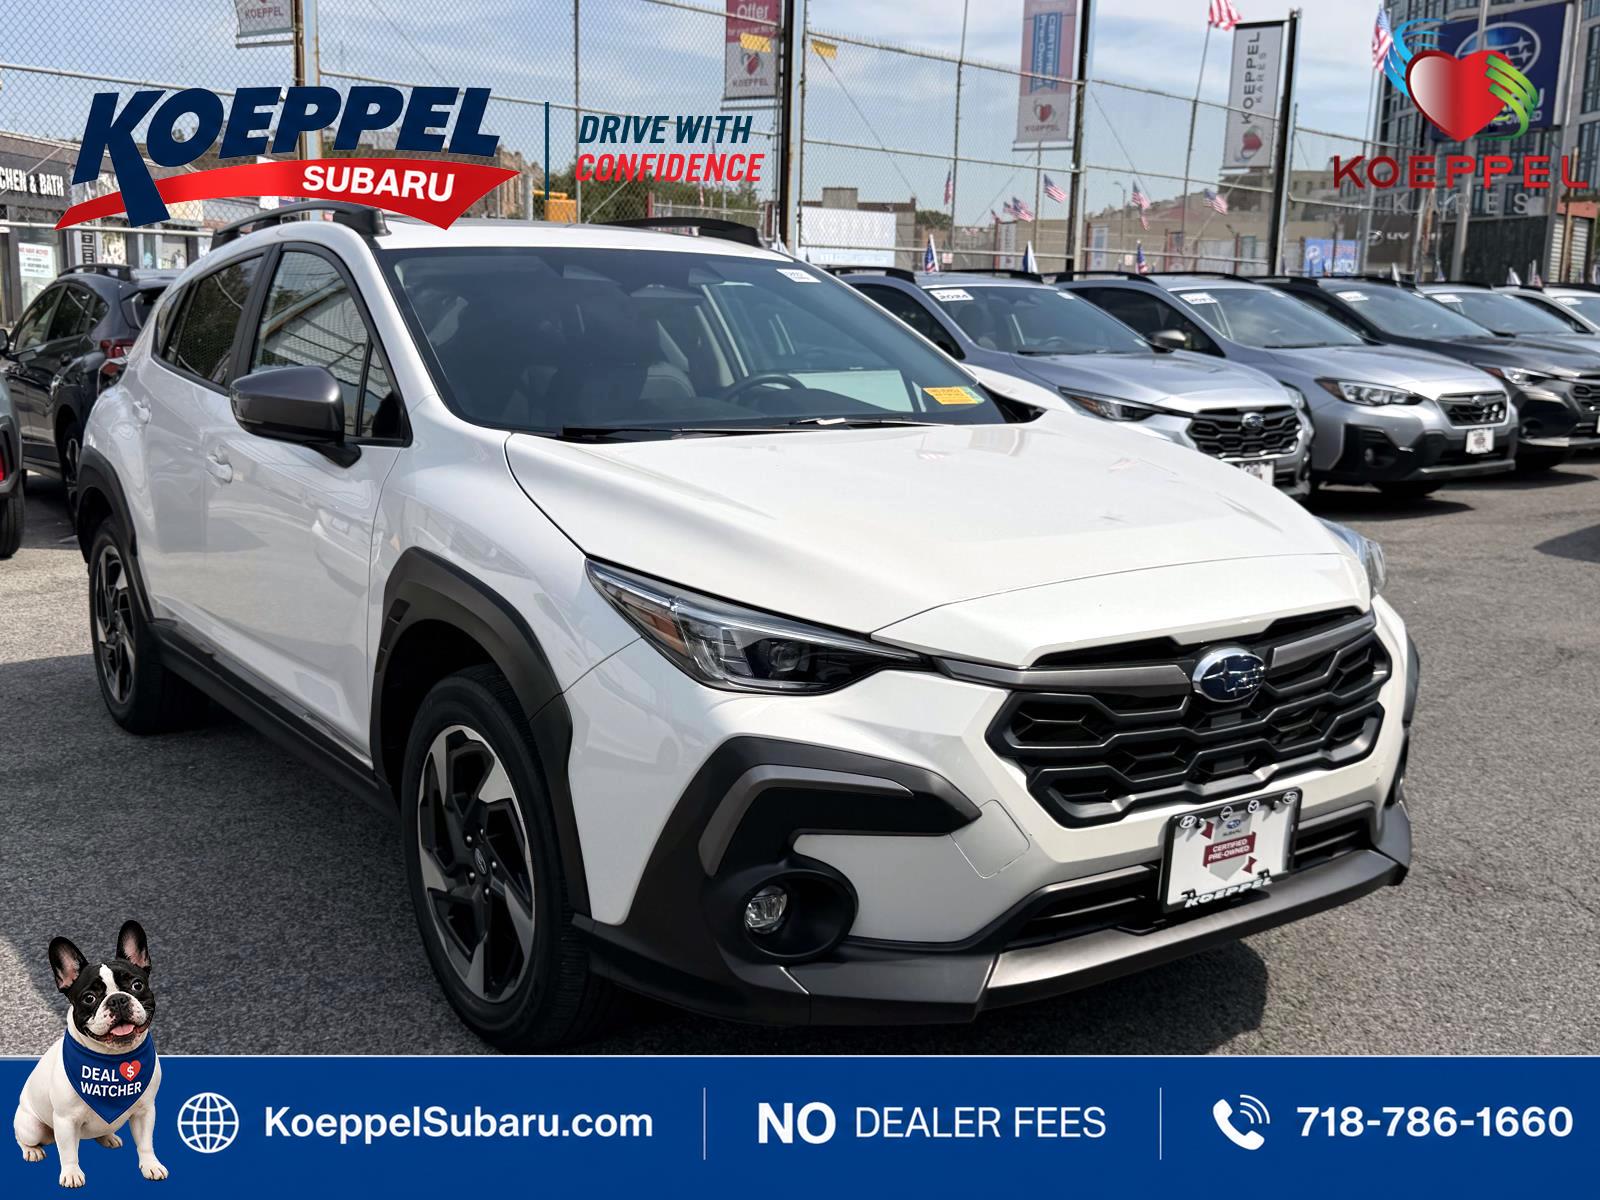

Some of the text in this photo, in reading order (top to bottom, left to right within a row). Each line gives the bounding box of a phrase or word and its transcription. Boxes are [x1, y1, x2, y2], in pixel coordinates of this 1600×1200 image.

[1241, 31, 1260, 125] KOEPPEL
[29, 174, 37, 194] &
[39, 173, 64, 196] BATH
[1208, 845, 1250, 861] PRE-OWNED
[1212, 838, 1248, 853] CERTIFIED
[1184, 877, 1272, 908] KOEPPEL
